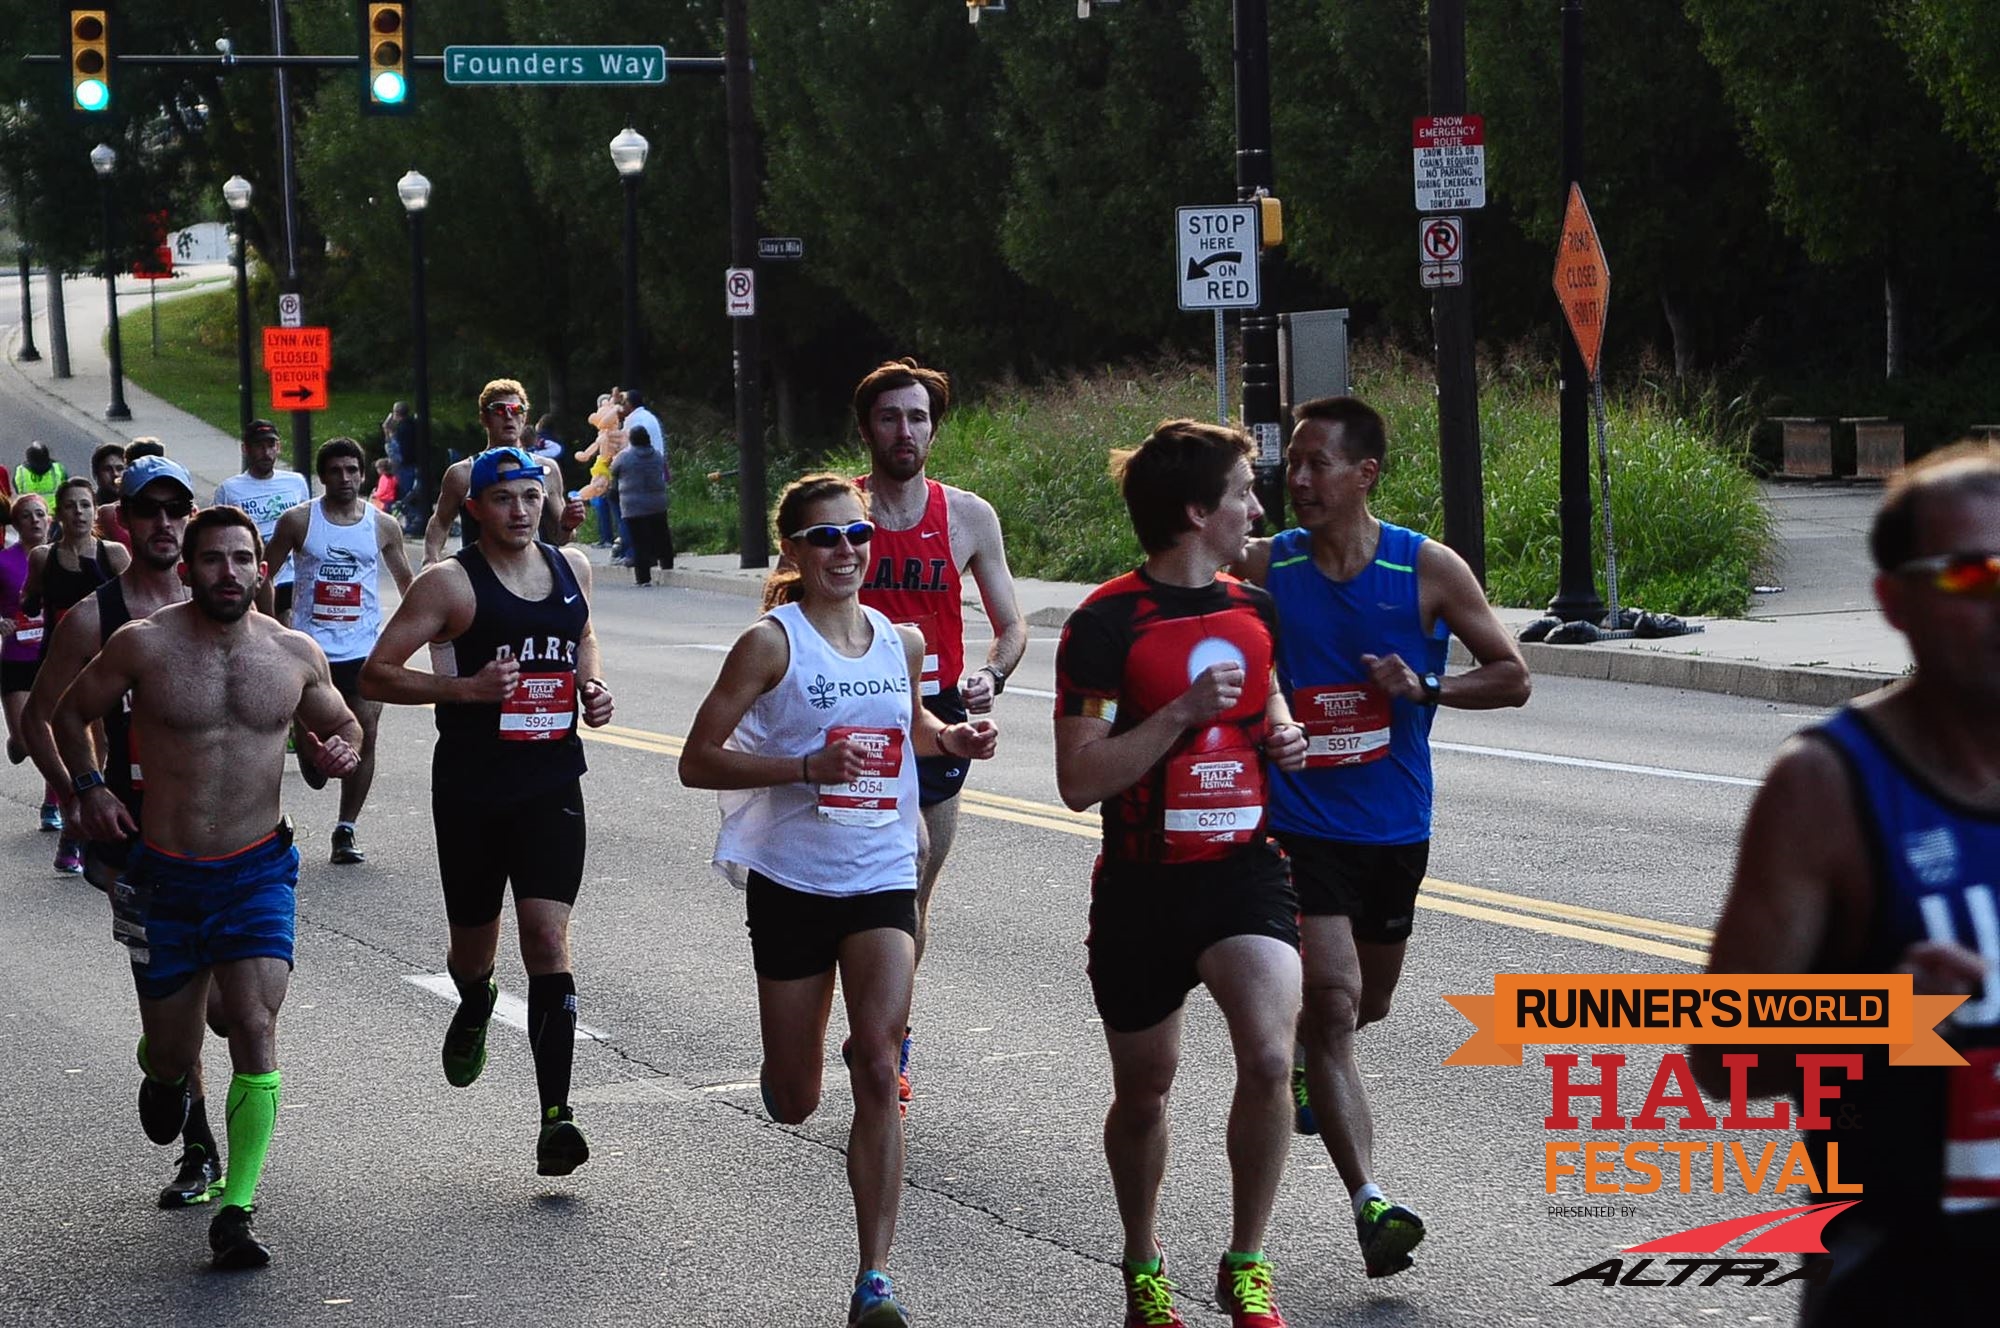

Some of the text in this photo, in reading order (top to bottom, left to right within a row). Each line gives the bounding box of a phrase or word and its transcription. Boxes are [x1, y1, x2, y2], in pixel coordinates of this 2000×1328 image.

[453, 53, 655, 79] Founders Way
[1432, 116, 1463, 127] SNOW
[1419, 126, 1476, 138] EMERGENCY
[1433, 137, 1463, 147] ROUTE
[1423, 148, 1442, 157] SNOW
[1420, 156, 1479, 168] CHAINS REQUIRED
[1426, 167, 1473, 178] NO PARKING
[1417, 177, 1482, 189] DURING EMERGENCY
[1433, 188, 1465, 198] VEHICLES
[1430, 198, 1472, 208] TOWED AWAY
[1189, 214, 1245, 235] STOP
[1200, 237, 1235, 250] HERE
[1218, 264, 1237, 277] ON
[1567, 265, 1598, 289] CLOSED
[1207, 280, 1250, 300] RED
[267, 334, 323, 346] LYNN AVE
[273, 350, 318, 364] CLOSED
[275, 370, 320, 382] DETOUR
[241, 500, 257, 510] NO
[320, 566, 355, 576] STOCKTON
[863, 556, 948, 591] .A.R.T.
[529, 685, 556, 693] HALF
[839, 677, 908, 697] RODALE
[1324, 700, 1357, 710] HALF
[1324, 709, 1359, 717] FESTIVAL
[524, 716, 554, 728] 5924
[1328, 737, 1361, 751] 5917
[859, 767, 881, 776] essica
[1200, 770, 1235, 782] HALF
[849, 780, 883, 794] 6054
[1200, 780, 1236, 789] FESTIVAL
[1198, 811, 1236, 827] 6270
